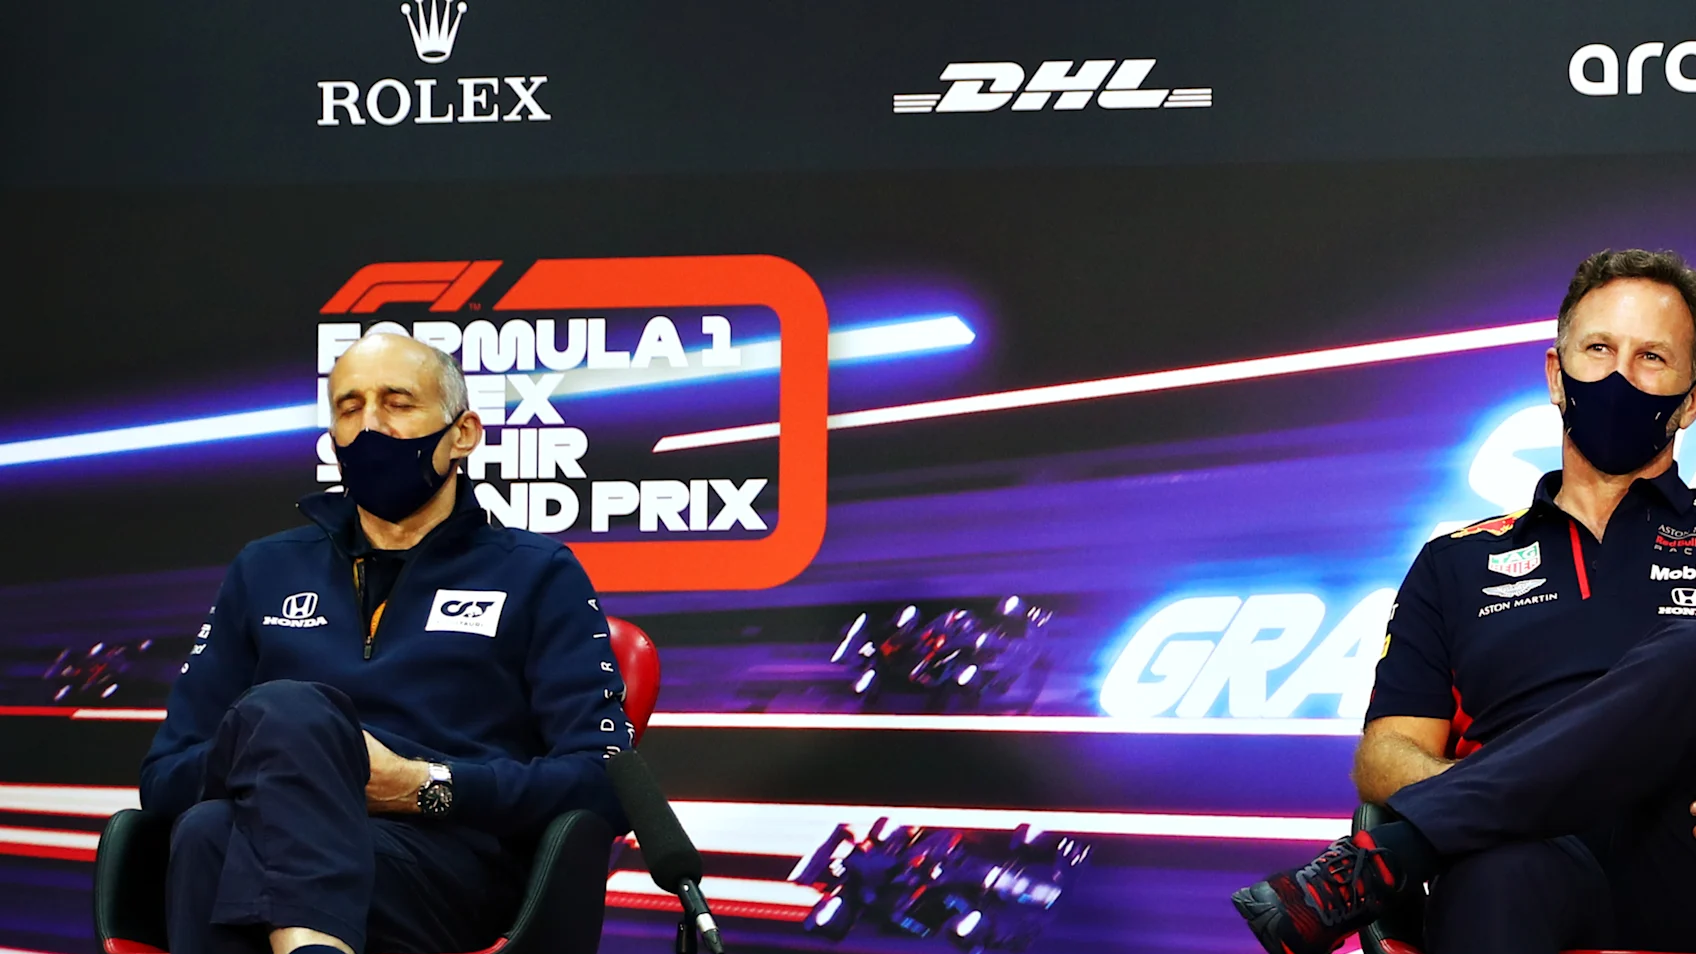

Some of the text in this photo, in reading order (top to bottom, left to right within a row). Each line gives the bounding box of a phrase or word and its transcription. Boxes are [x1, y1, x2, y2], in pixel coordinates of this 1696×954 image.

[317, 76, 551, 126] ROLEX
[935, 59, 1157, 112] DHL
[317, 316, 741, 374] FRMULA 1
[591, 478, 768, 532] PRIX
[1656, 535, 1677, 547] Red
[1658, 524, 1690, 538] ASTON
[1491, 545, 1538, 565] TAG
[262, 616, 328, 628] HONDA
[1478, 592, 1558, 617] ASTON MARTIN
[1099, 587, 1398, 719] GRA
